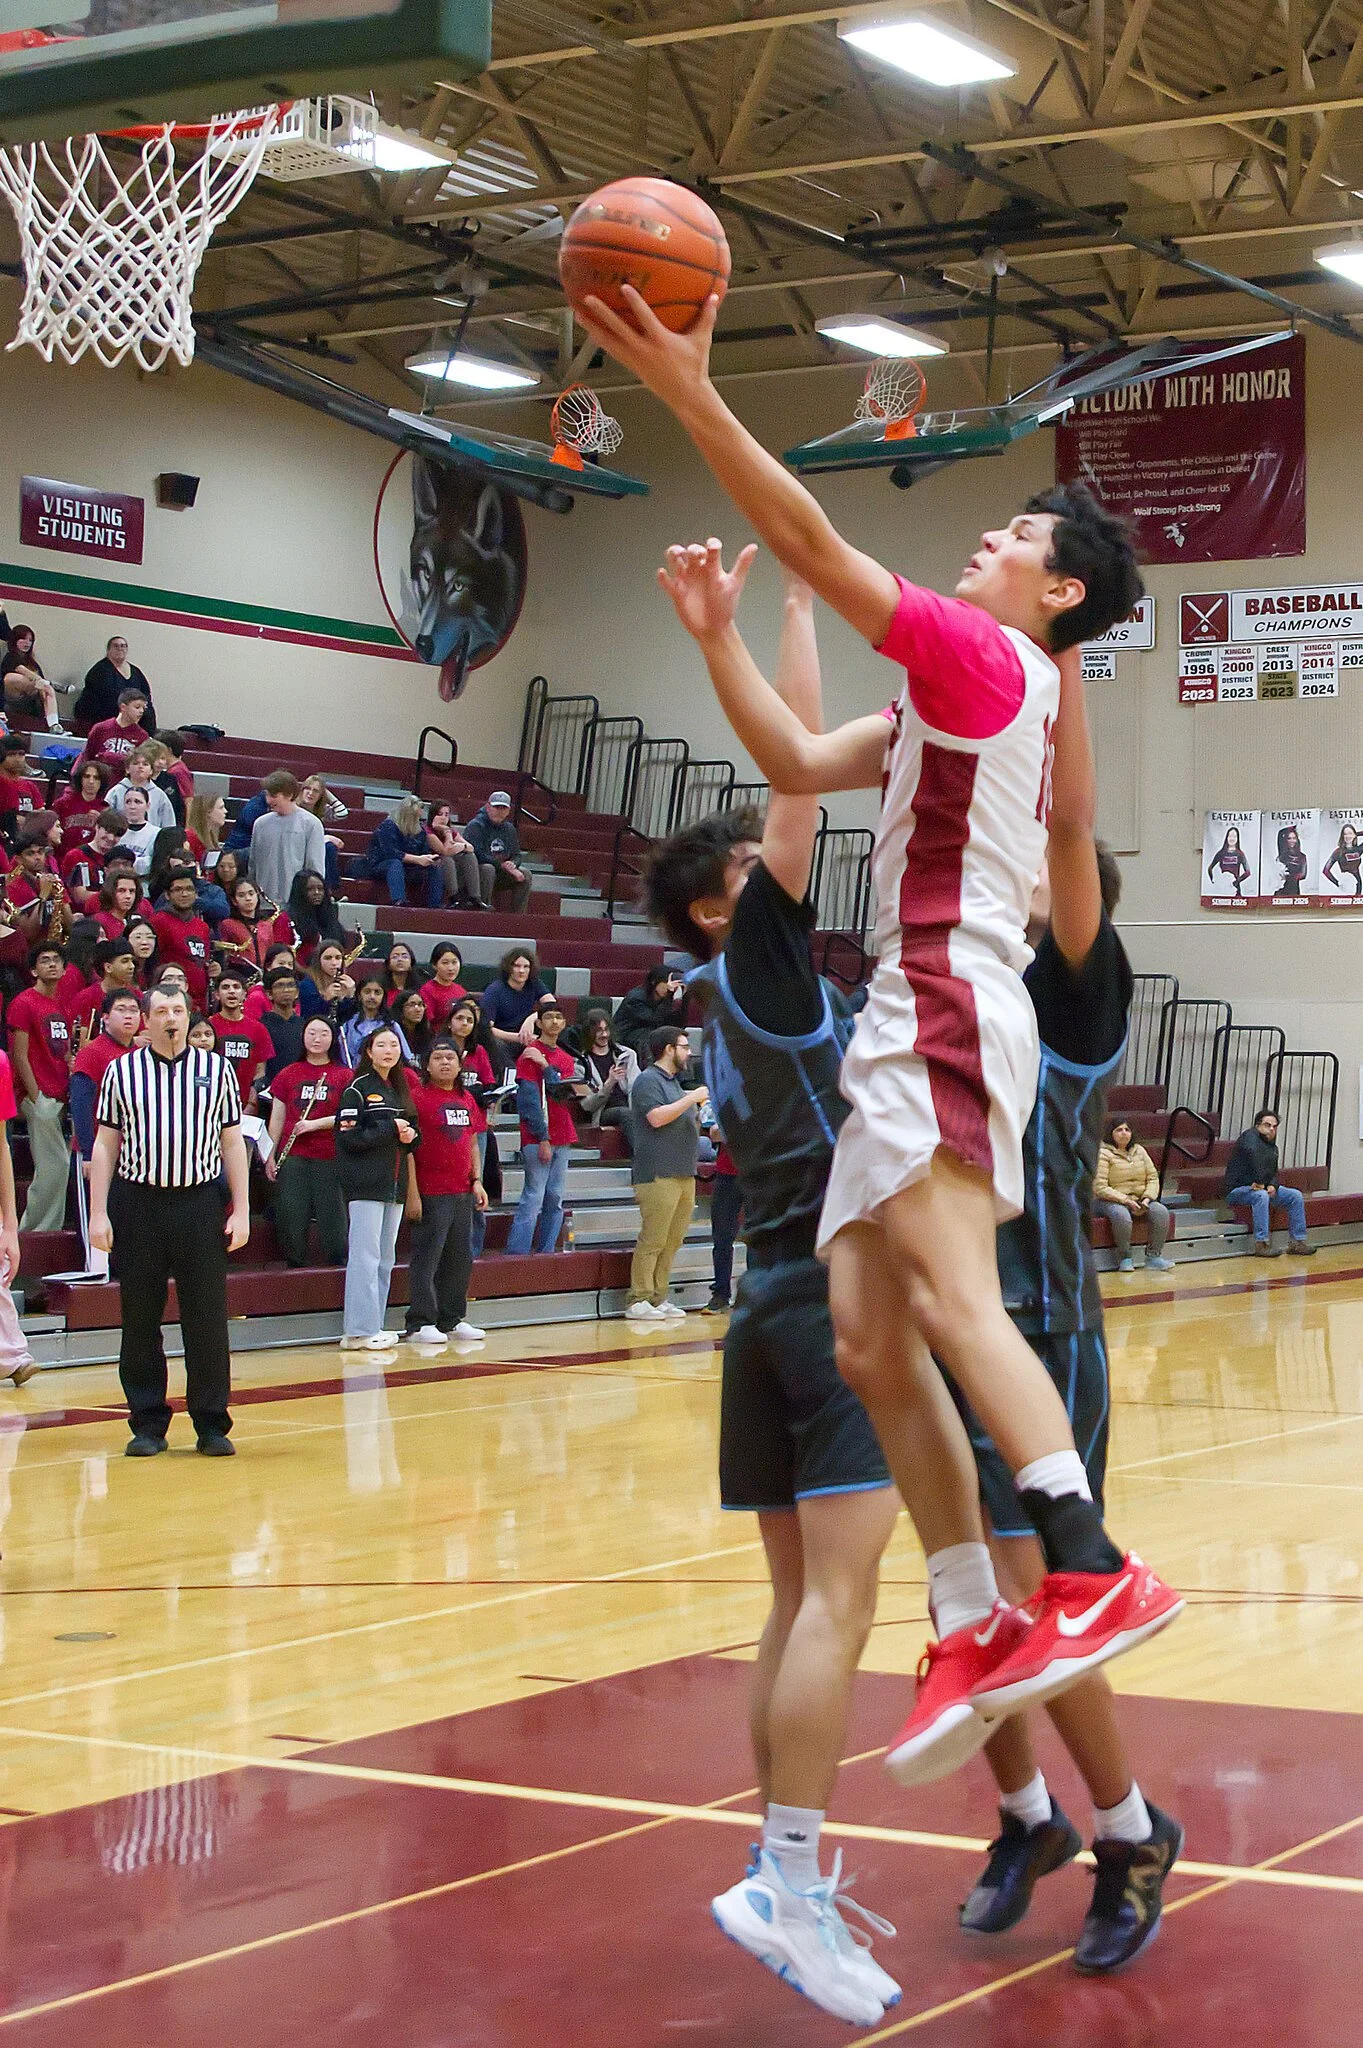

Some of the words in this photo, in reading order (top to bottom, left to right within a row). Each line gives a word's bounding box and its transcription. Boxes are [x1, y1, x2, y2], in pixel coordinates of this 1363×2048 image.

[1069, 378, 1158, 415] ICTORY
[1164, 376, 1215, 408] WITH
[1222, 368, 1291, 403] HONOR
[1123, 415, 1148, 424] School
[1093, 429, 1109, 438] Play
[1110, 428, 1127, 437] Hard
[1093, 440, 1108, 449] Play
[1093, 452, 1108, 461] Play
[1109, 451, 1130, 460] Clean
[1181, 457, 1193, 465] the
[1195, 455, 1224, 465] Officials
[1254, 451, 1278, 460] Game
[1104, 472, 1132, 481] Humble
[1142, 471, 1168, 481] Victory
[1169, 469, 1183, 477] and
[1185, 467, 1216, 477] Gracious
[1217, 466, 1225, 474] in
[1226, 464, 1251, 473] Defeat
[1102, 491, 1112, 500] Be
[1113, 490, 1132, 500] Loud,
[1134, 490, 1144, 498] Be
[1145, 488, 1169, 498] Proud,
[1170, 487, 1184, 496] and
[1185, 486, 1207, 495] Cheer
[1208, 484, 1219, 494] for
[1220, 483, 1231, 493] US
[42, 494, 123, 527] VISITING
[1134, 507, 1152, 516] Wolf
[1152, 505, 1177, 516] Strong
[1178, 503, 1194, 513] Pack
[1195, 502, 1221, 513] Strong
[38, 516, 126, 549] STUDENTS
[1245, 592, 1363, 616] BASEBALL
[1254, 616, 1353, 633] CHAMPIONS
[1304, 643, 1332, 651] KINGCO
[1222, 662, 1254, 673] 2000
[1262, 660, 1294, 671] 2013
[1301, 657, 1335, 669] 2014
[1082, 668, 1112, 678] 2024
[1183, 664, 1215, 675] 1996
[1221, 676, 1253, 684] DISTRICT
[1181, 689, 1215, 701] 2023
[1221, 687, 1254, 699] 2023
[1262, 687, 1294, 698] 2023
[1302, 684, 1335, 695] 2024
[1211, 812, 1253, 821] EASTLAKE
[1271, 811, 1312, 820] EASTLAKE
